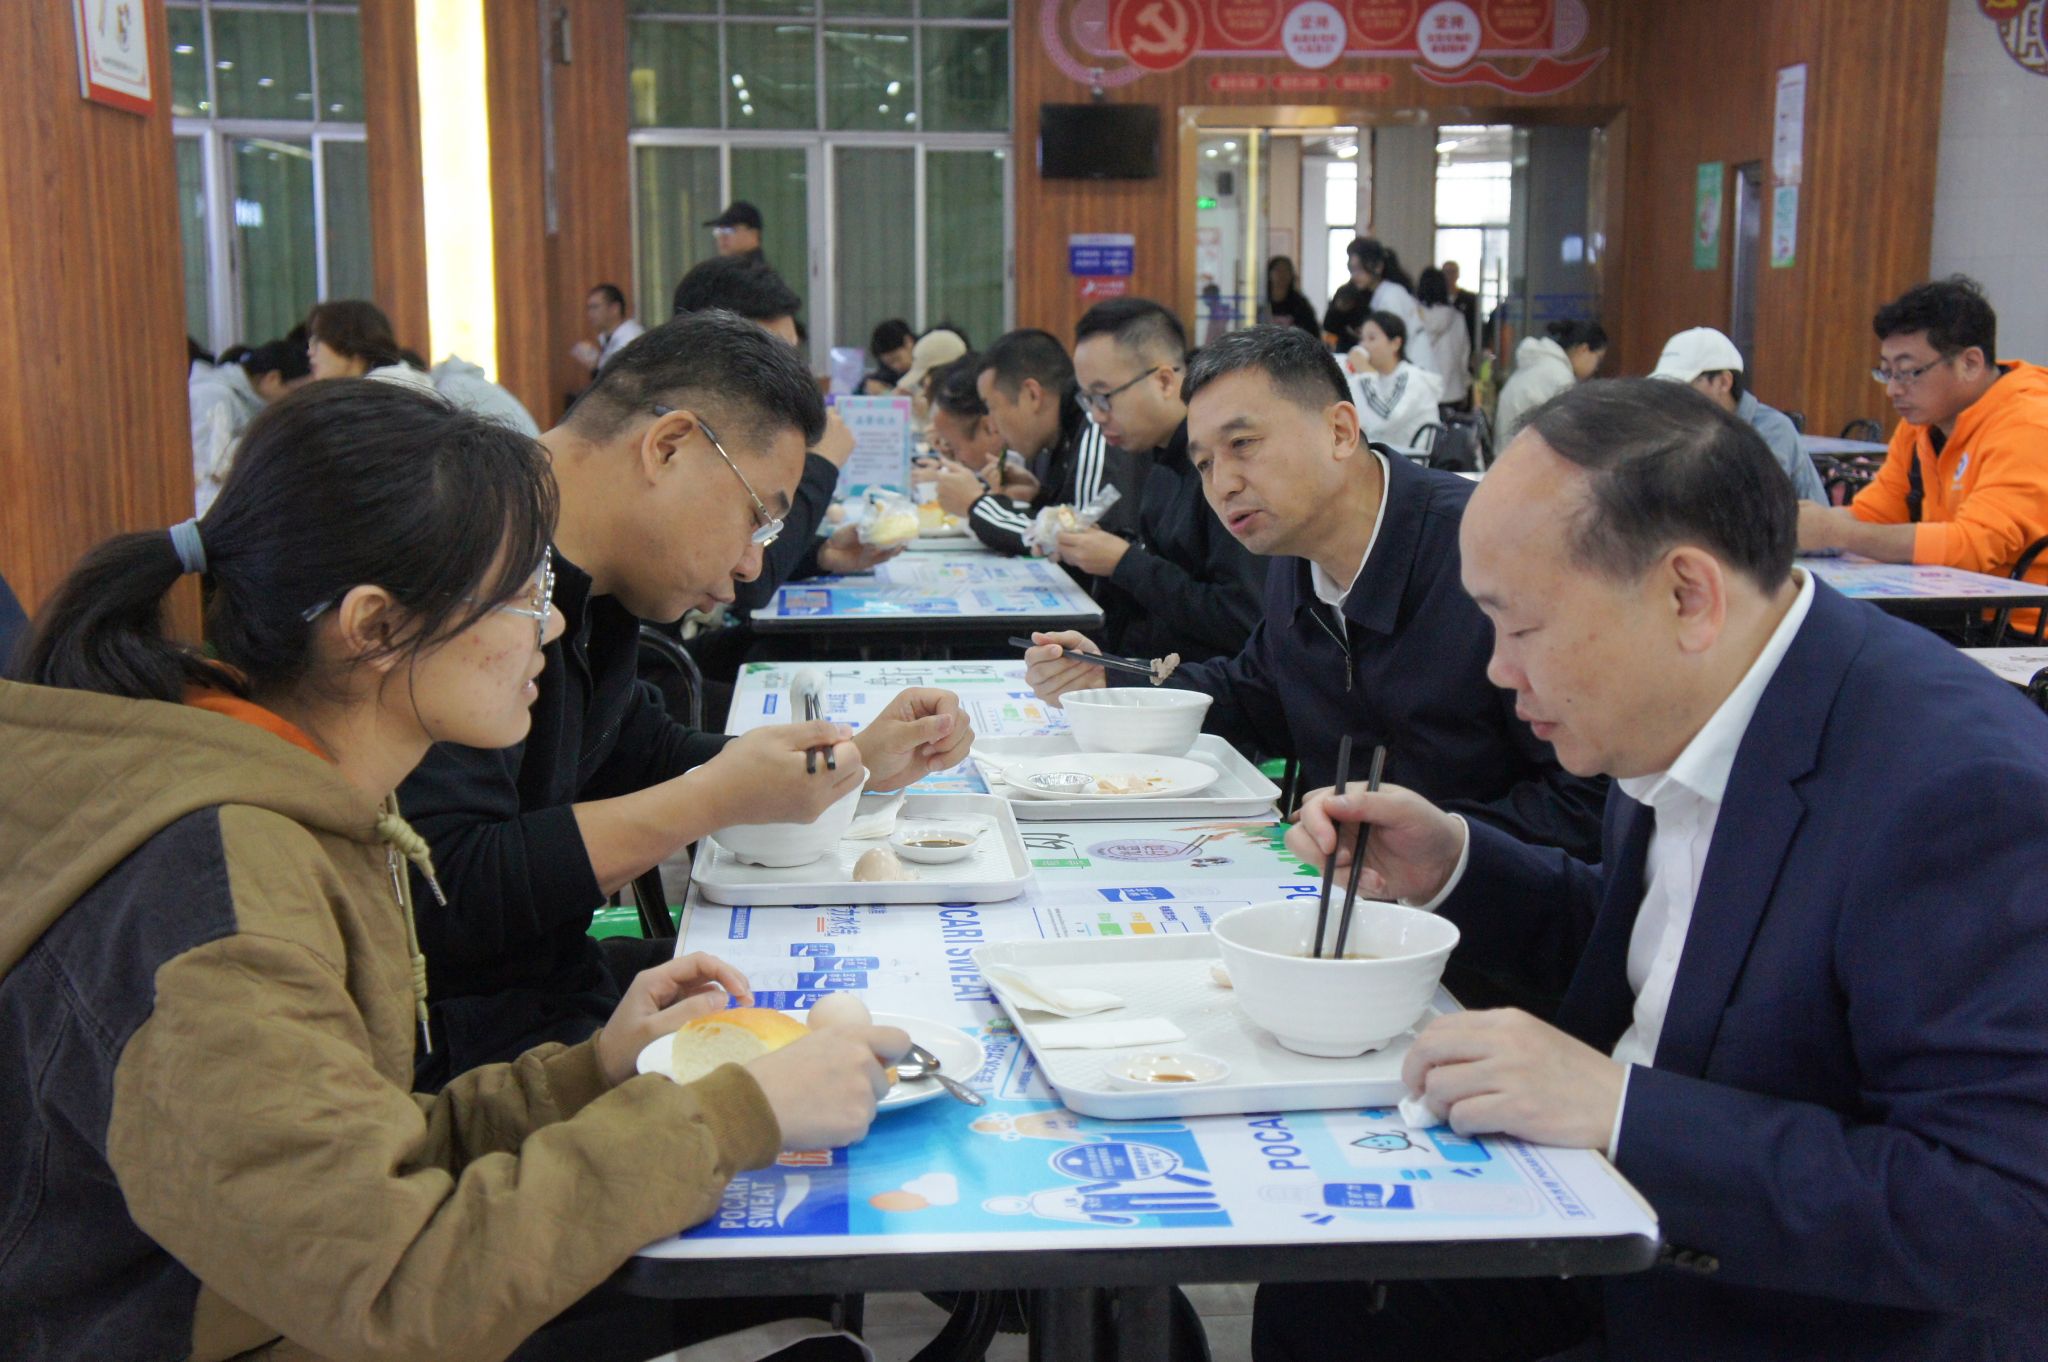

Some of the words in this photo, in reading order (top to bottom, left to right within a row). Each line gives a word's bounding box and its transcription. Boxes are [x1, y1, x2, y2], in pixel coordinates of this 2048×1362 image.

[946, 948, 999, 1005] SWEAT
[719, 1177, 749, 1229] POCARI
[749, 1181, 775, 1229] SWEAT
